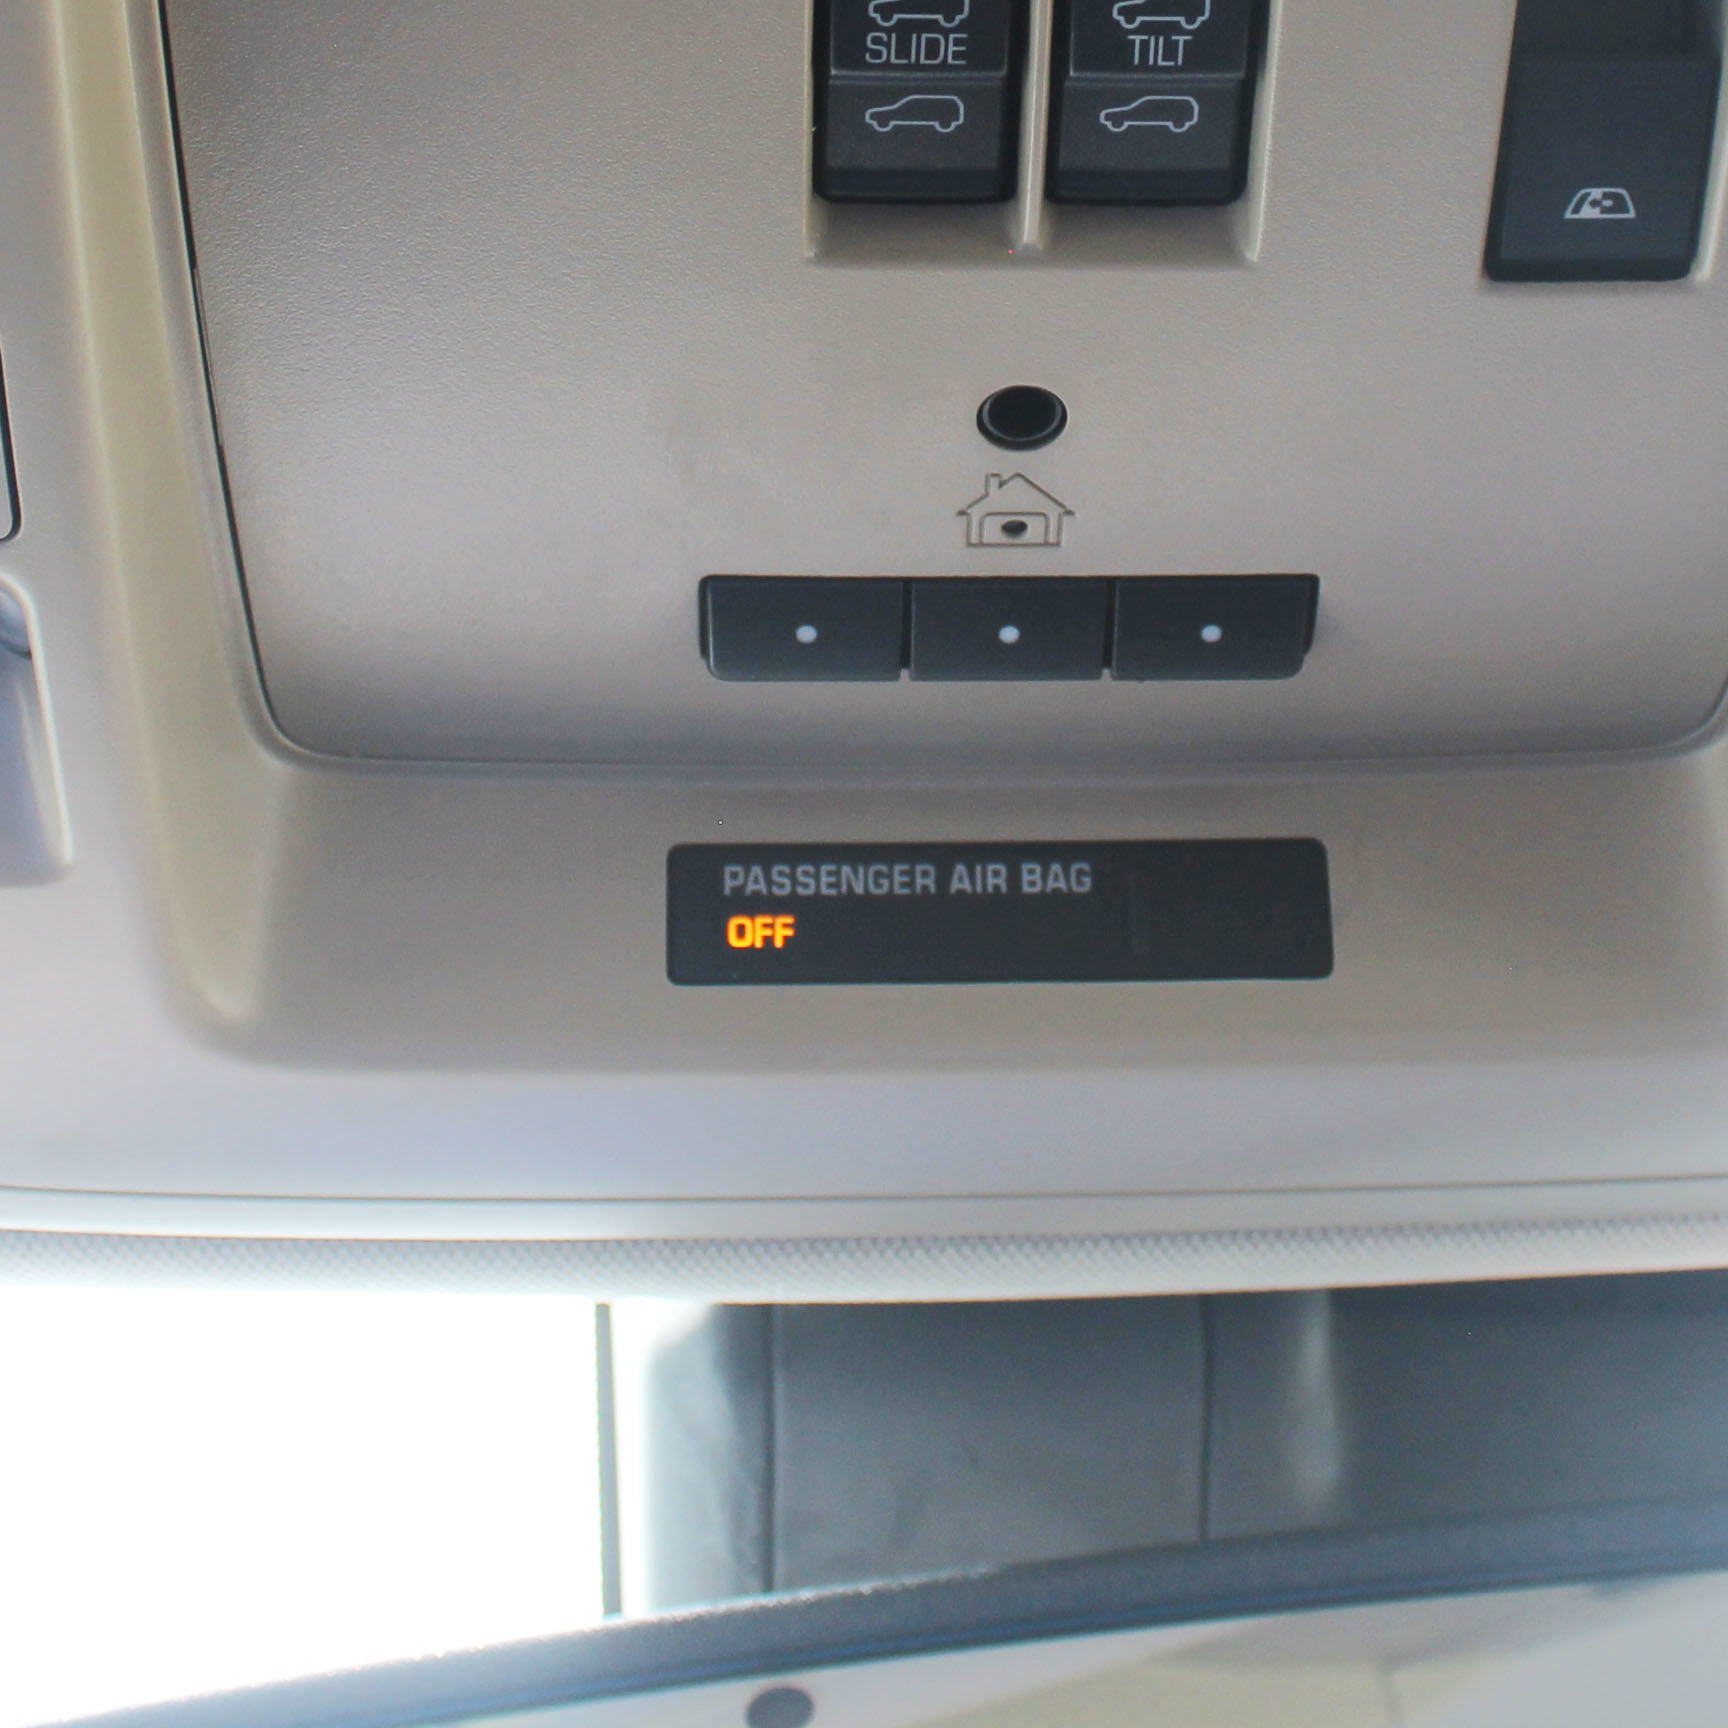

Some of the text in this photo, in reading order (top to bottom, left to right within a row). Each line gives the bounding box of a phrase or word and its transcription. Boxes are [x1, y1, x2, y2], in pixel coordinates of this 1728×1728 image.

[865, 32, 969, 65] SLIDE
[1127, 35, 1192, 66] TILT
[723, 862, 1093, 897] PASSENGER AIR BAG
[725, 914, 796, 950] OFF
